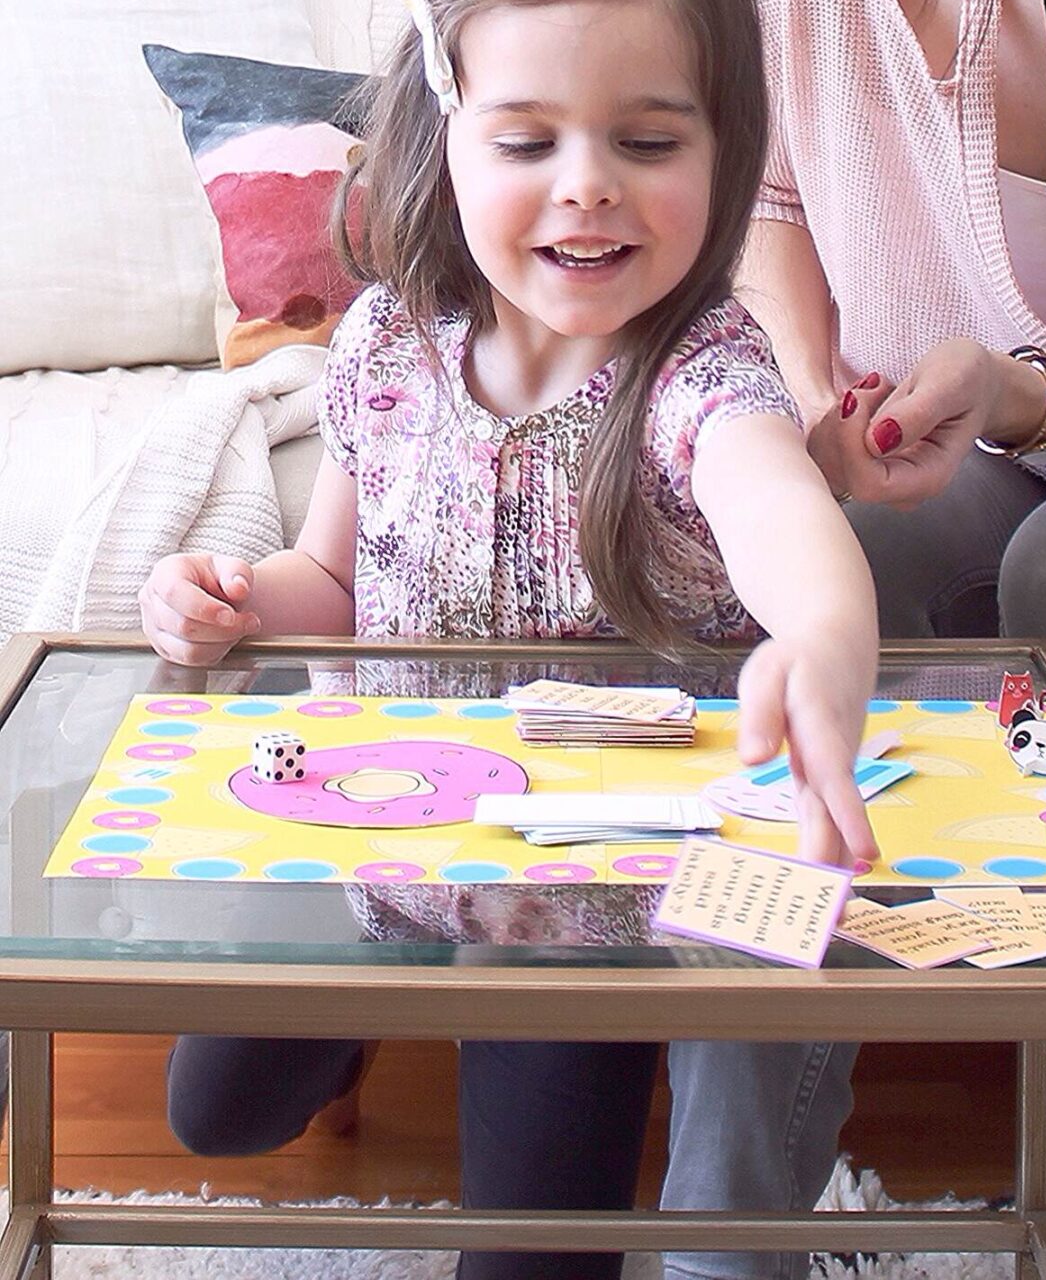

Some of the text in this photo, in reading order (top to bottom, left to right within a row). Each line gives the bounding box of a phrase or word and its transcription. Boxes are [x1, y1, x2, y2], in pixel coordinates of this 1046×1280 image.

[693, 870, 717, 910] said
[709, 855, 747, 930] your sis
[732, 873, 766, 925] thing
[752, 864, 793, 944] funniest
[783, 894, 806, 926] the
[800, 883, 835, 951] What's
